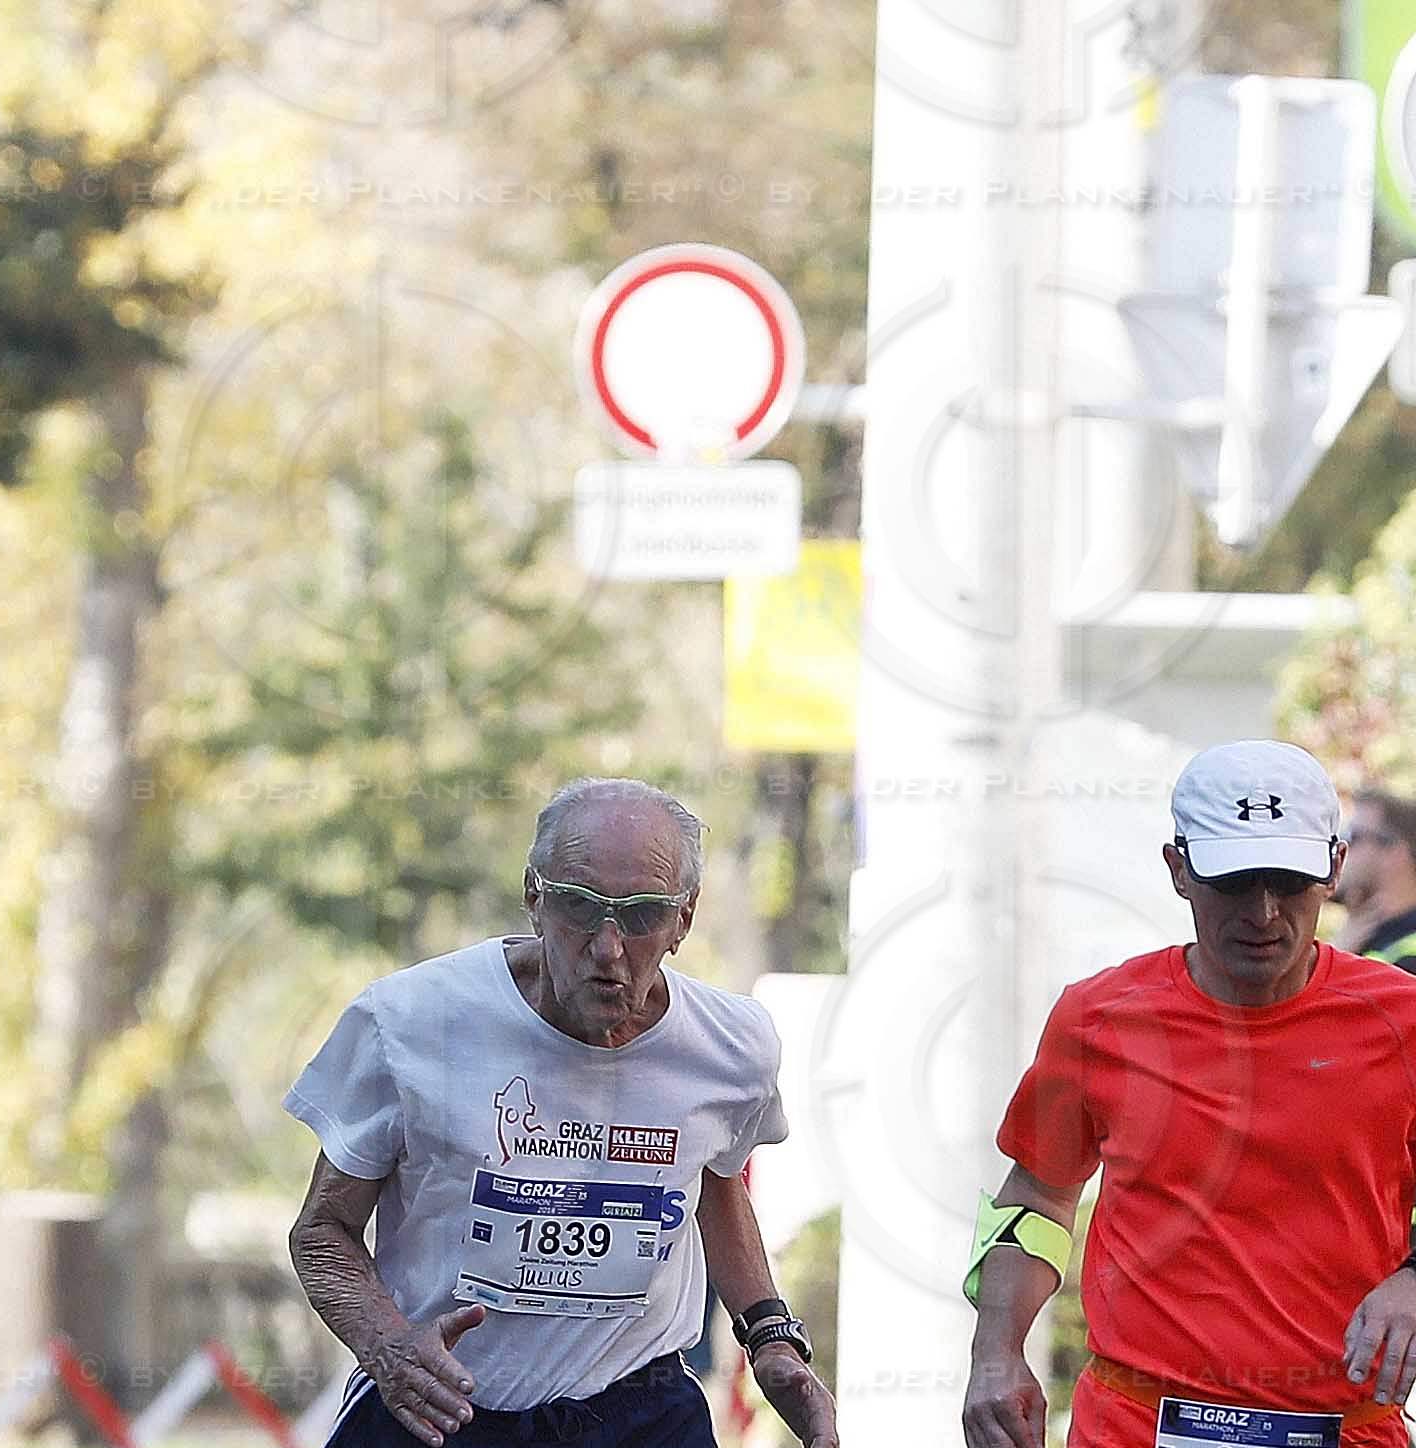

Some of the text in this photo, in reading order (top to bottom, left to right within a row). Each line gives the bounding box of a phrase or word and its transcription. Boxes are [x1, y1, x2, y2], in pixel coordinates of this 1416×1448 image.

[559, 1121, 604, 1140] GRAZ
[612, 1129, 675, 1147] KLEINE
[513, 1137, 603, 1161] MARATHON
[610, 1147, 674, 1162] ZEITUNG
[520, 1182, 567, 1199] GRAZ
[506, 1195, 552, 1207] MARATHON
[515, 1219, 612, 1258] 1839
[1202, 1408, 1251, 1427] GRAZ
[1191, 1421, 1235, 1434] MARATHON
